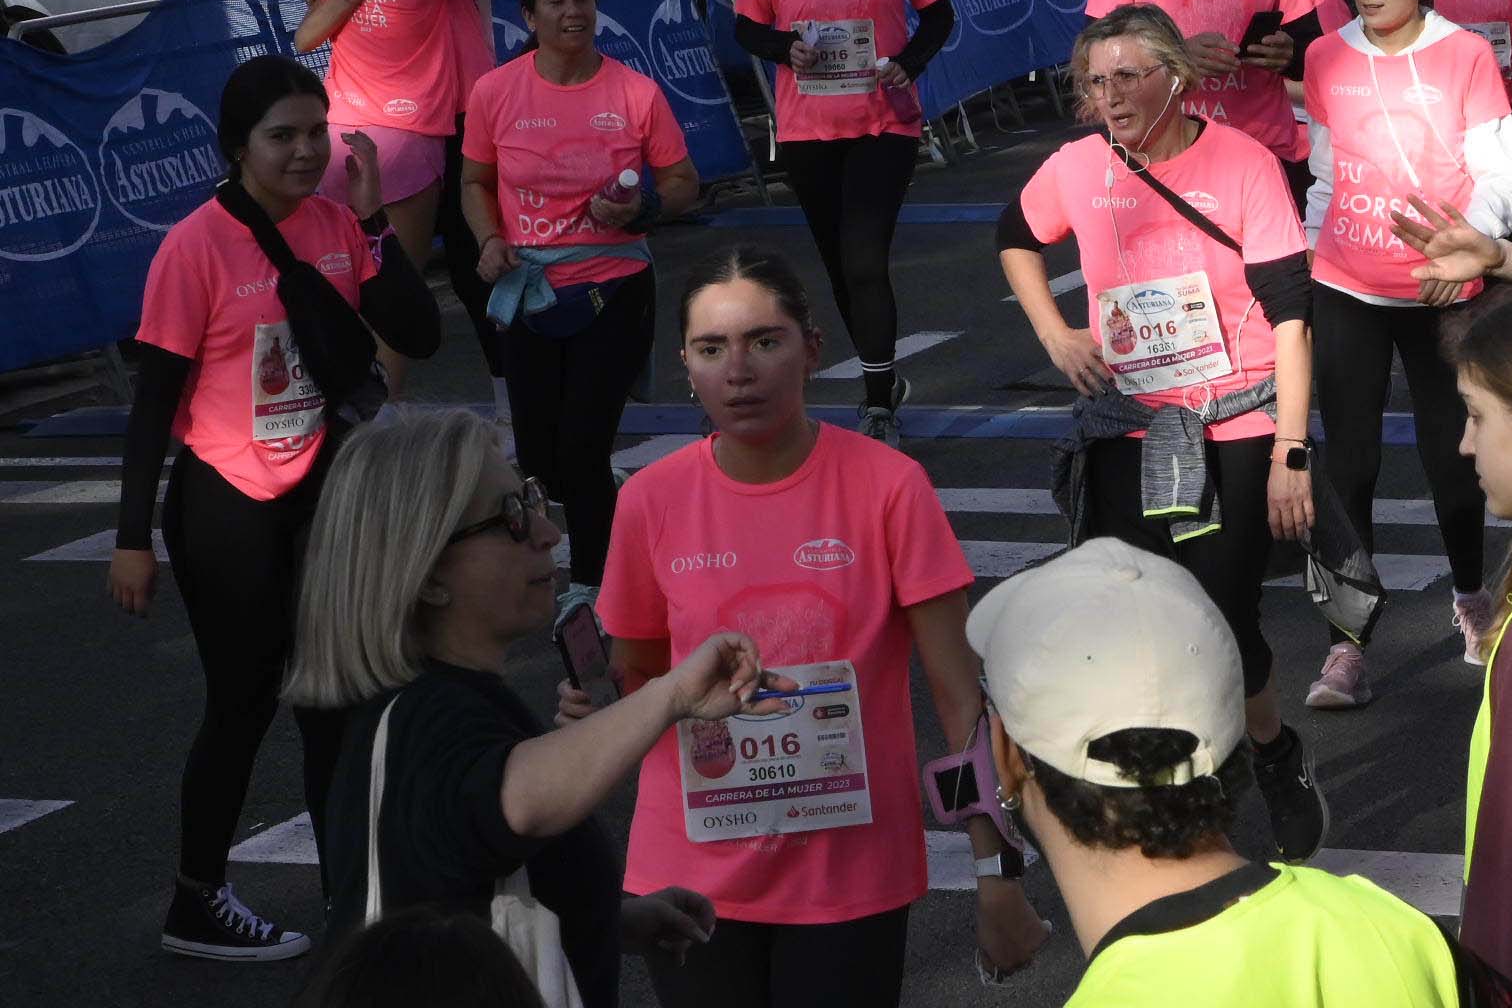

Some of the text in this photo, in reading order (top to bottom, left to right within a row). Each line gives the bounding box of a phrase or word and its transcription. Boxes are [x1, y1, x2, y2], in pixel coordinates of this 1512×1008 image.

[820, 49, 849, 61] 016
[515, 118, 557, 130] OYSHO
[112, 143, 224, 204] ASTURIANA
[1338, 160, 1363, 184] TU
[517, 187, 545, 208] TU
[1092, 196, 1138, 209] OYSHO
[1339, 194, 1421, 222] DORSA
[518, 214, 602, 239] DORSA
[1333, 216, 1406, 250] SUMA
[1139, 320, 1177, 341] 016
[1119, 362, 1151, 372] CARRERA
[265, 416, 305, 431] OYSHO
[671, 552, 737, 574] OYSHO
[740, 732, 801, 761] 016
[749, 763, 796, 782] 30610
[705, 780, 851, 804] CARRERA DE LA MUJER 2023
[703, 802, 858, 829] OYSHO Santander
